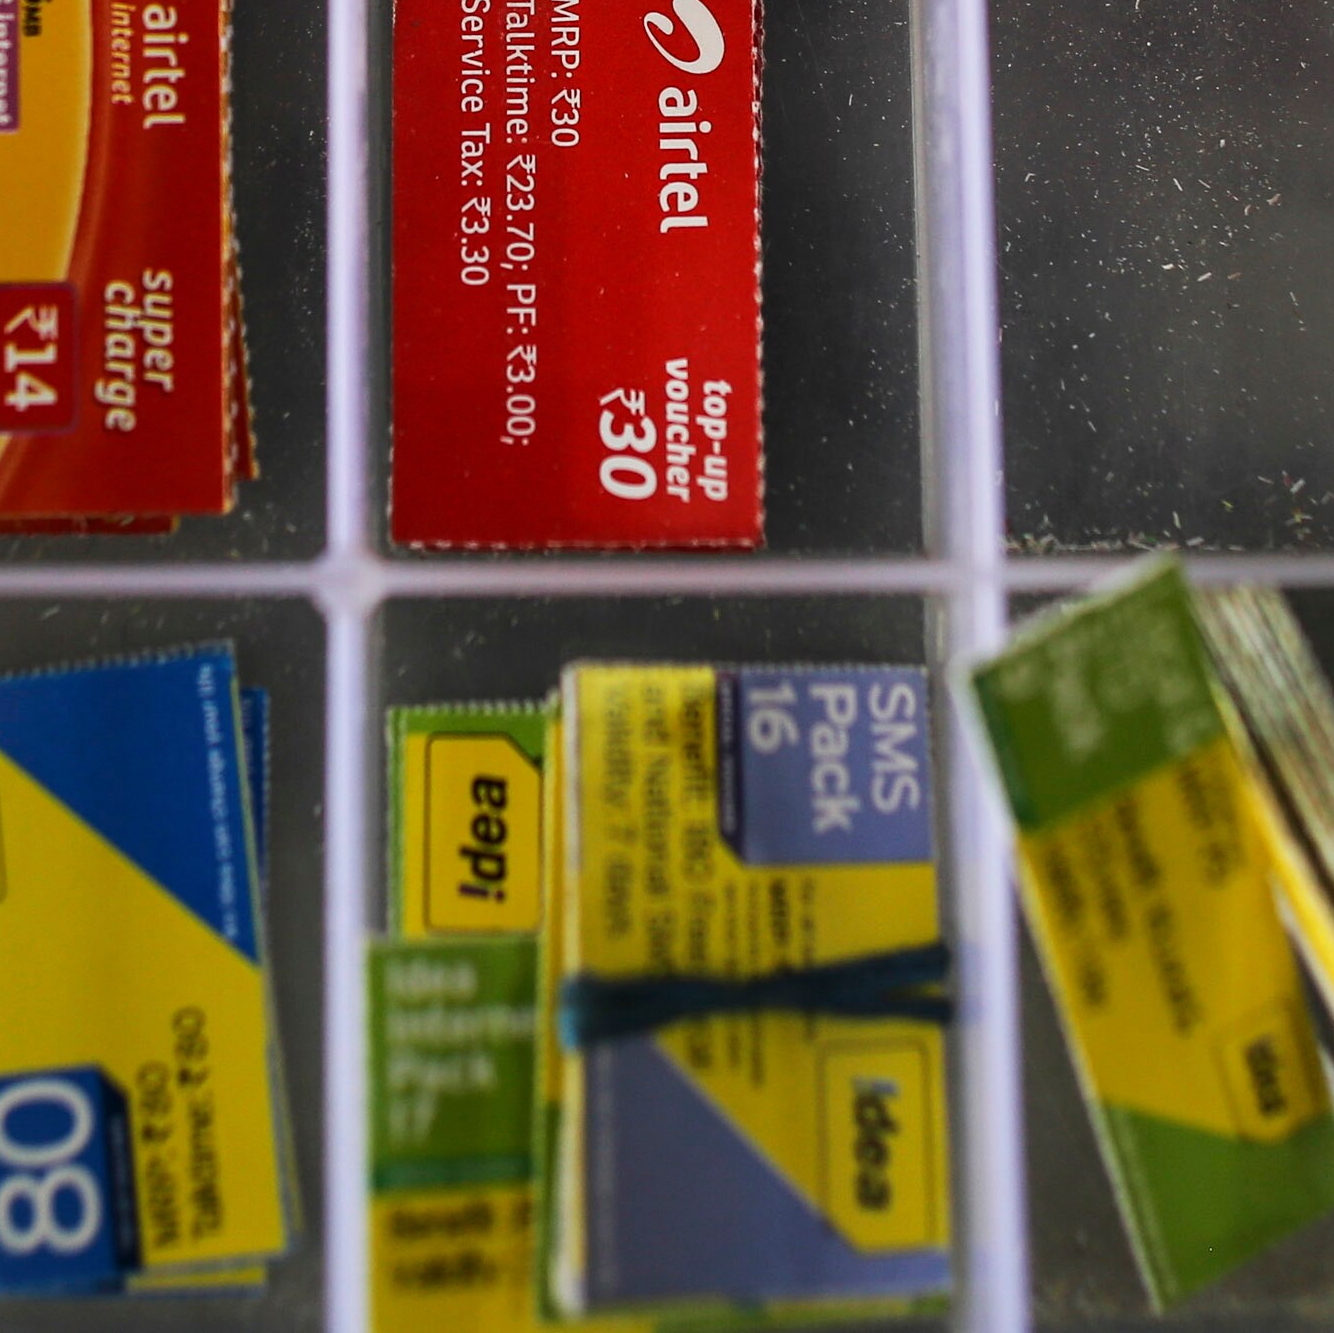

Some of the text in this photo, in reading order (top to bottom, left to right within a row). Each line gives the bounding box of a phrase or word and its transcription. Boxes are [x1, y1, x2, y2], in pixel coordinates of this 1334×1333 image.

[109, 2, 136, 105] internet
[142, 4, 188, 129] airtel
[460, 123, 491, 187] Tax:
[549, 89, 581, 147] ₹30
[657, 87, 712, 234] airtel
[459, 196, 491, 286] ₹3.30
[501, 154, 537, 271] ₹23.70;
[3, 304, 60, 411] ₹14
[95, 281, 141, 432] charge
[135, 269, 175, 391] super
[505, 283, 536, 335] PF:
[500, 345, 537, 446] ₹3.00;
[598, 387, 657, 500] ₹30
[664, 358, 695, 502] voucher
[695, 380, 732, 501] top-up
[746, 685, 797, 754] 16
[807, 683, 859, 834] Pack
[867, 682, 920, 814] SMS
[458, 774, 508, 902] idea
